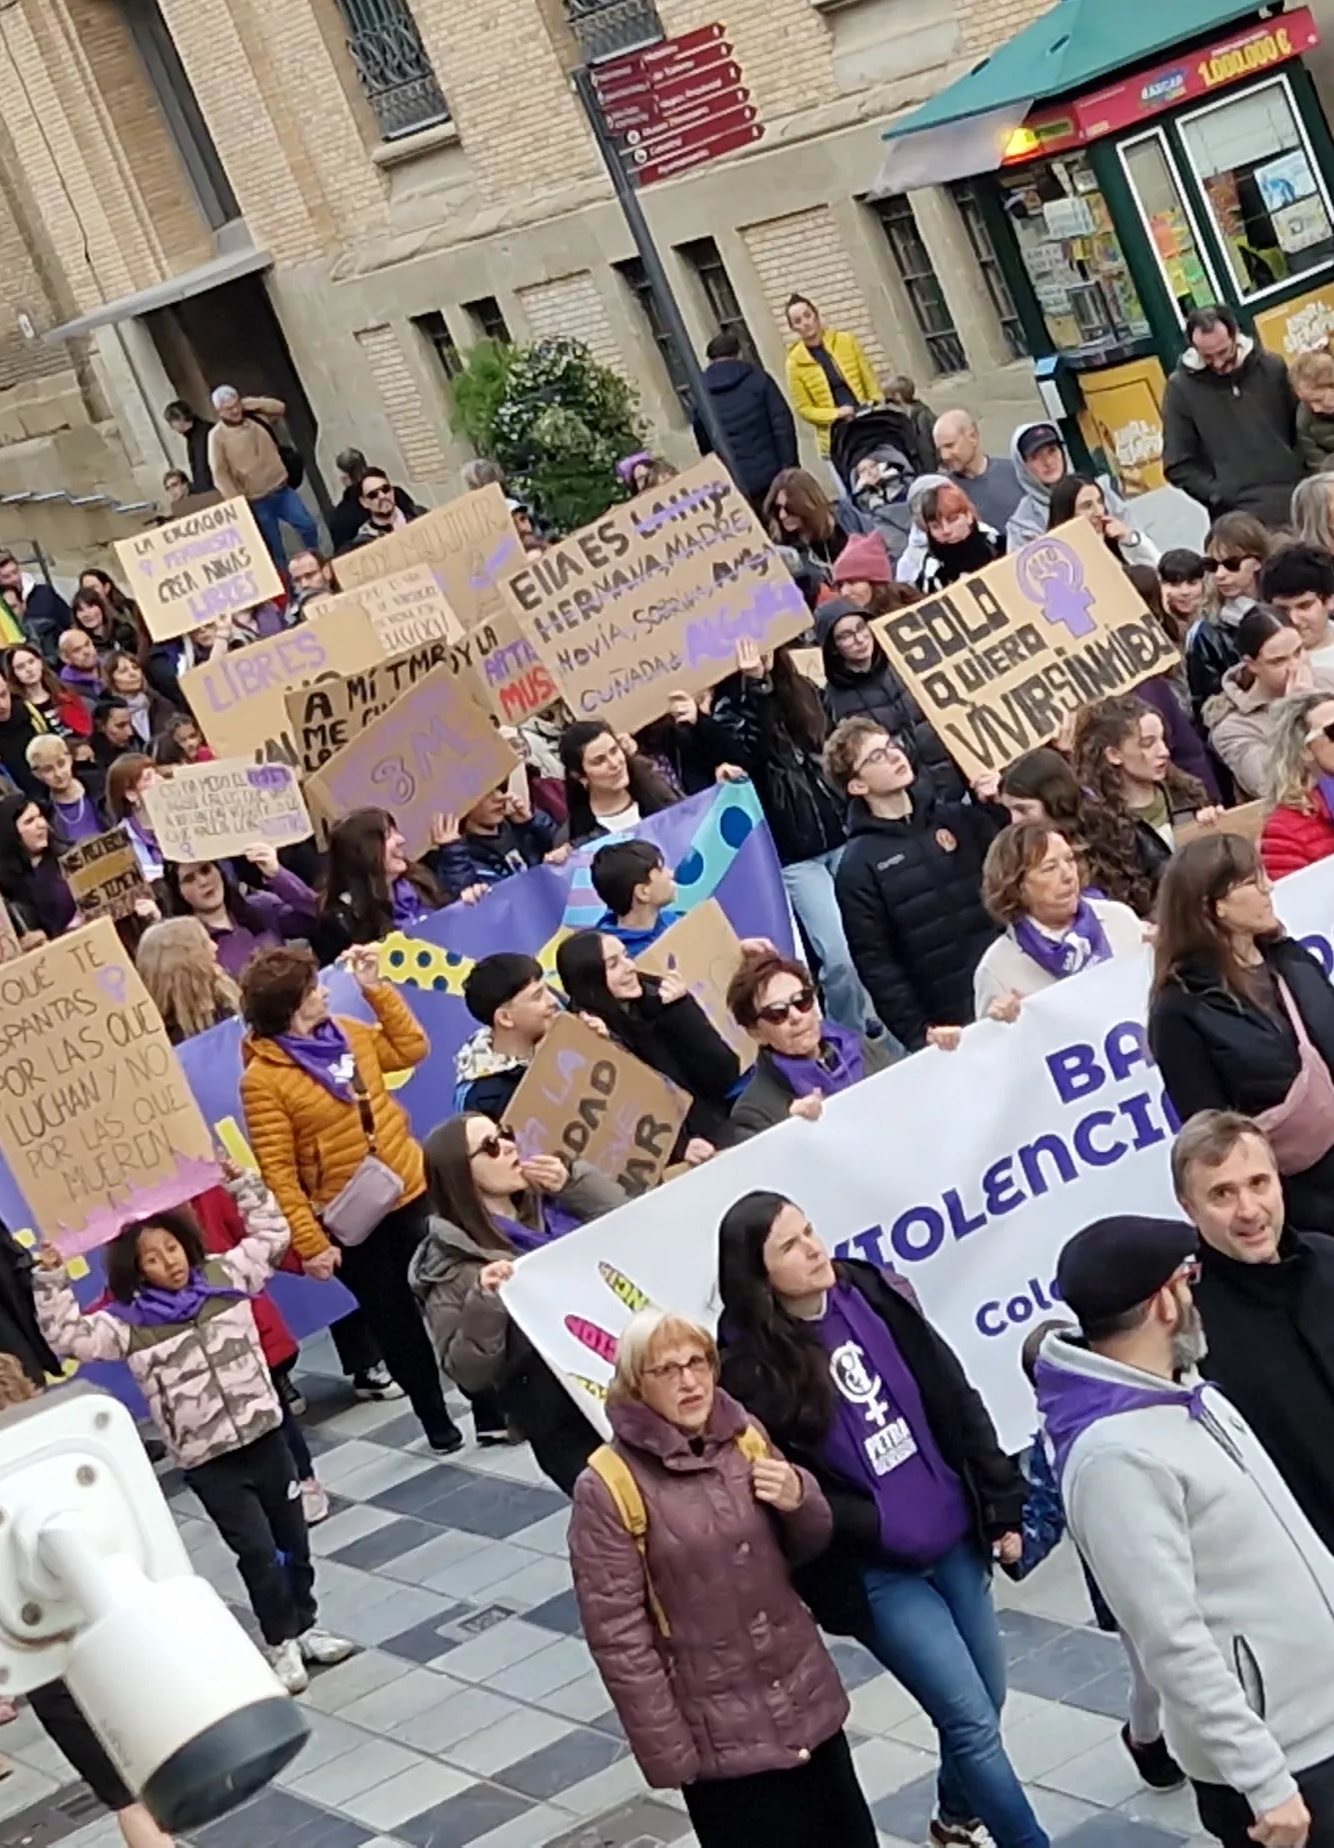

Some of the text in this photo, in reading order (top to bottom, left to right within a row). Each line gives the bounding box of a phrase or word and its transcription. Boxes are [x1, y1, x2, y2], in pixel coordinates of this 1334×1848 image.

[133, 538, 156, 556] LA
[577, 520, 630, 570] ES
[158, 571, 199, 604] CREA
[883, 576, 1011, 676] SOLO
[201, 631, 328, 713] LIBRES
[499, 664, 559, 721] MUS
[921, 621, 1051, 713] QUIERO
[302, 718, 350, 753] ME
[303, 690, 334, 725] A
[371, 714, 470, 806] 8M
[67, 938, 106, 975] TE
[46, 1023, 105, 1074] LAS
[105, 999, 163, 1049] QUE
[5, 1041, 170, 1148] LUCHAN Y NO
[24, 1082, 191, 1180] POR LAS QUE
[61, 1122, 176, 1204] MUEREN
